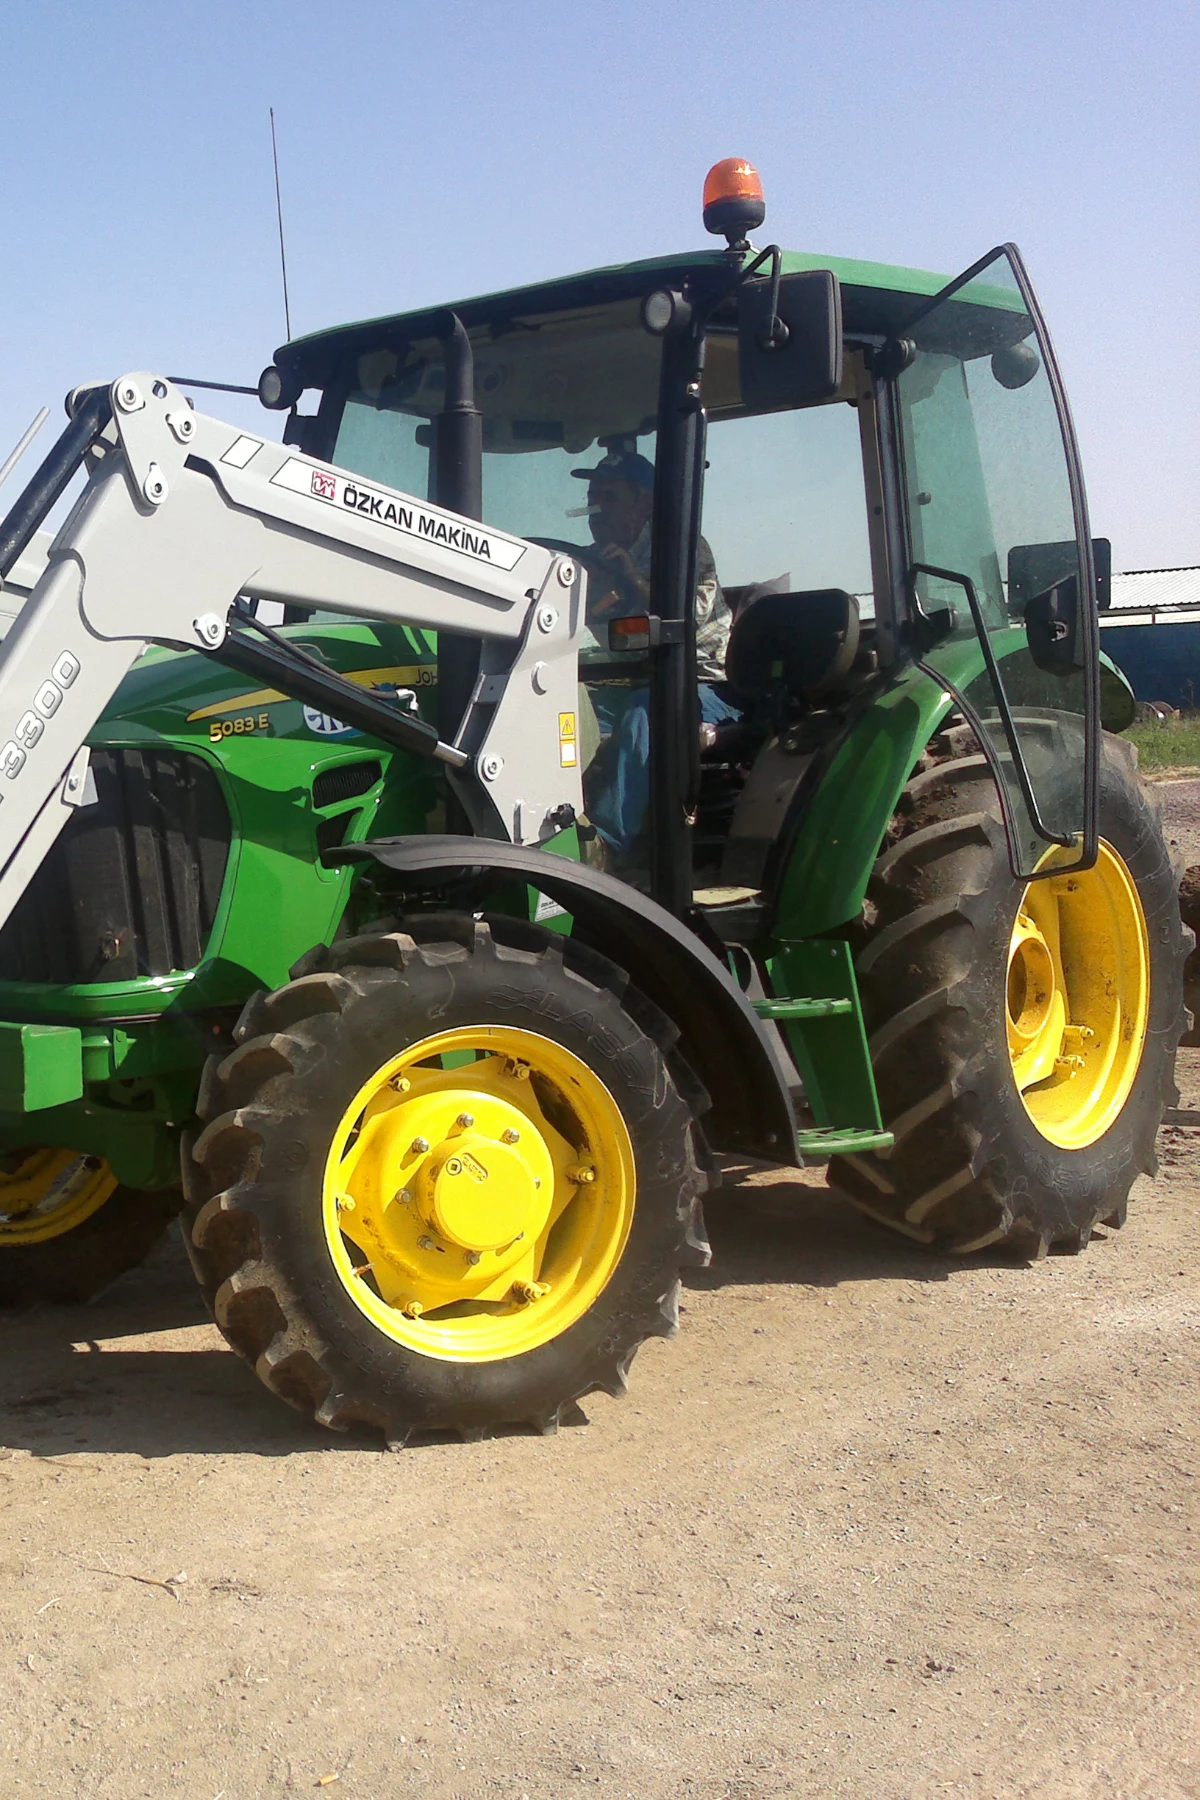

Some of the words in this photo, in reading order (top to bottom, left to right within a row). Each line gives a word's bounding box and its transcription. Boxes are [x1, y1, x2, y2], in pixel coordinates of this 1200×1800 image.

[343, 483, 413, 530] ÖZKAN
[418, 514, 491, 560] MAKİNA
[209, 715, 255, 742] 5083
[259, 713, 270, 730] E
